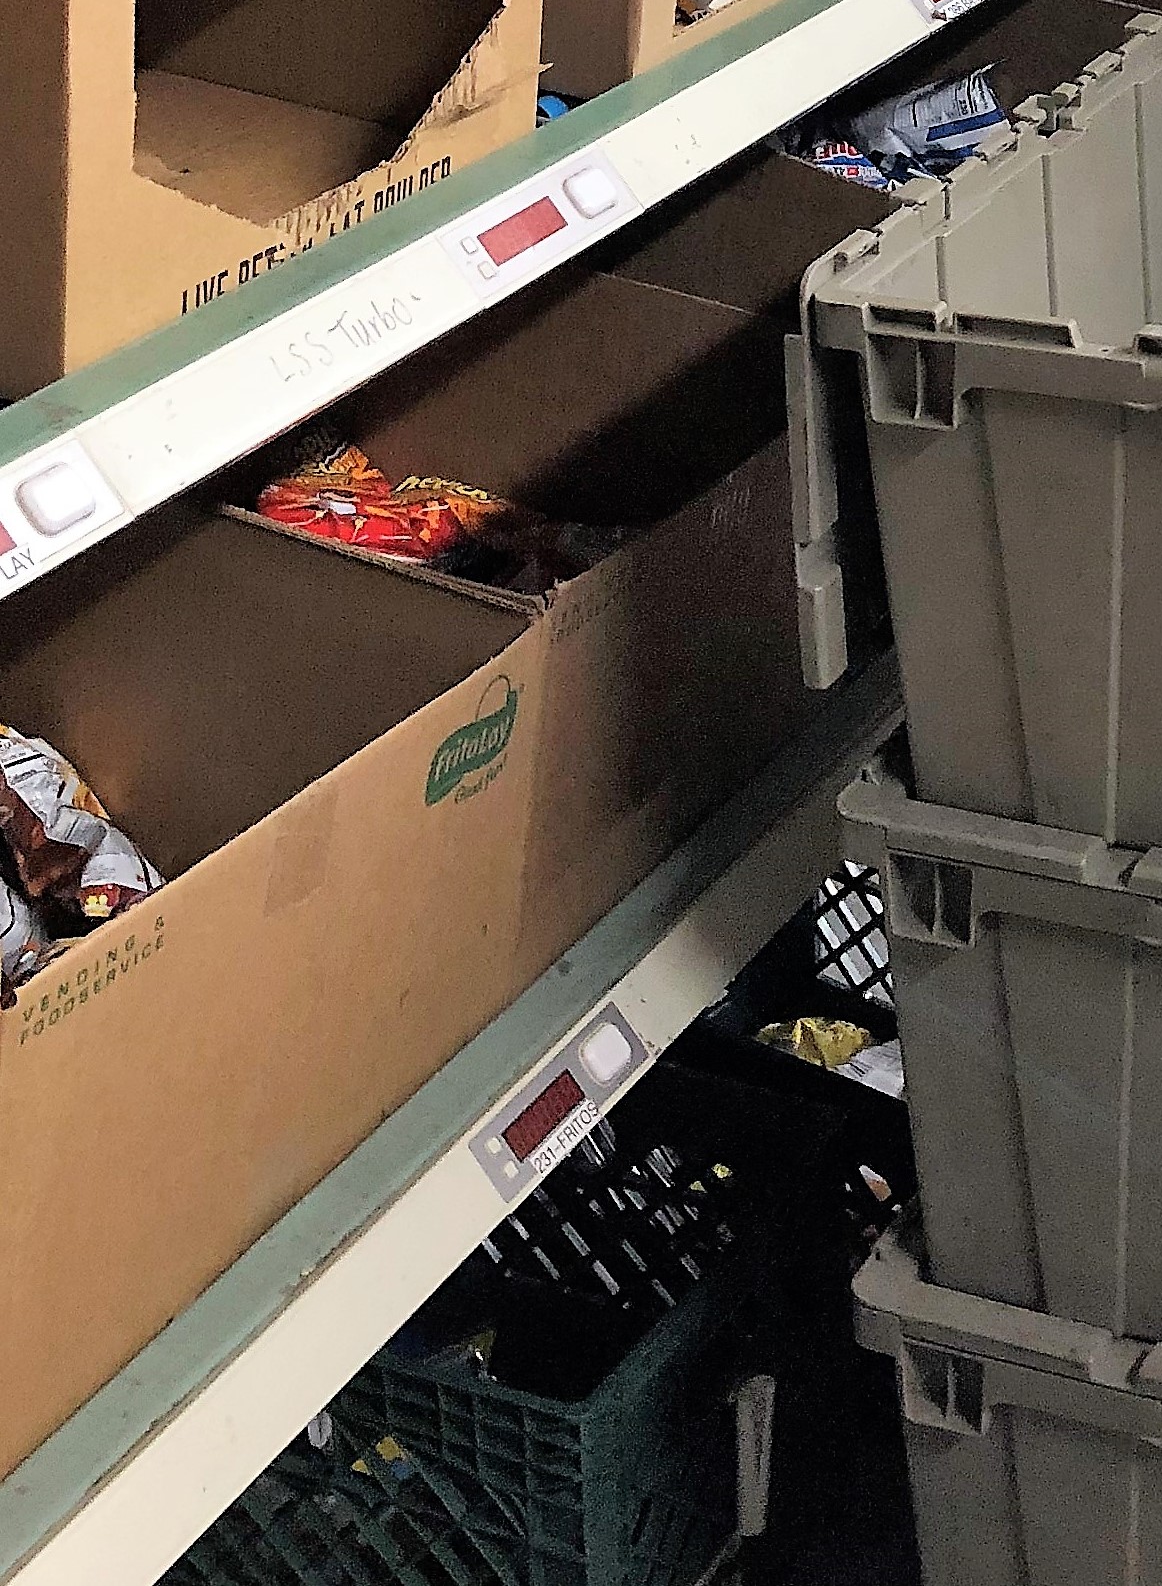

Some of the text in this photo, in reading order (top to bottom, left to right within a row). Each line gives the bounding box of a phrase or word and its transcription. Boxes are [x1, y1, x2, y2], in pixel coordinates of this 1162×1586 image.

[19, 933, 165, 1047] FOODSERVICE
[22, 934, 136, 1023] VENDING
[533, 1101, 600, 1174] 231-FRITOS
